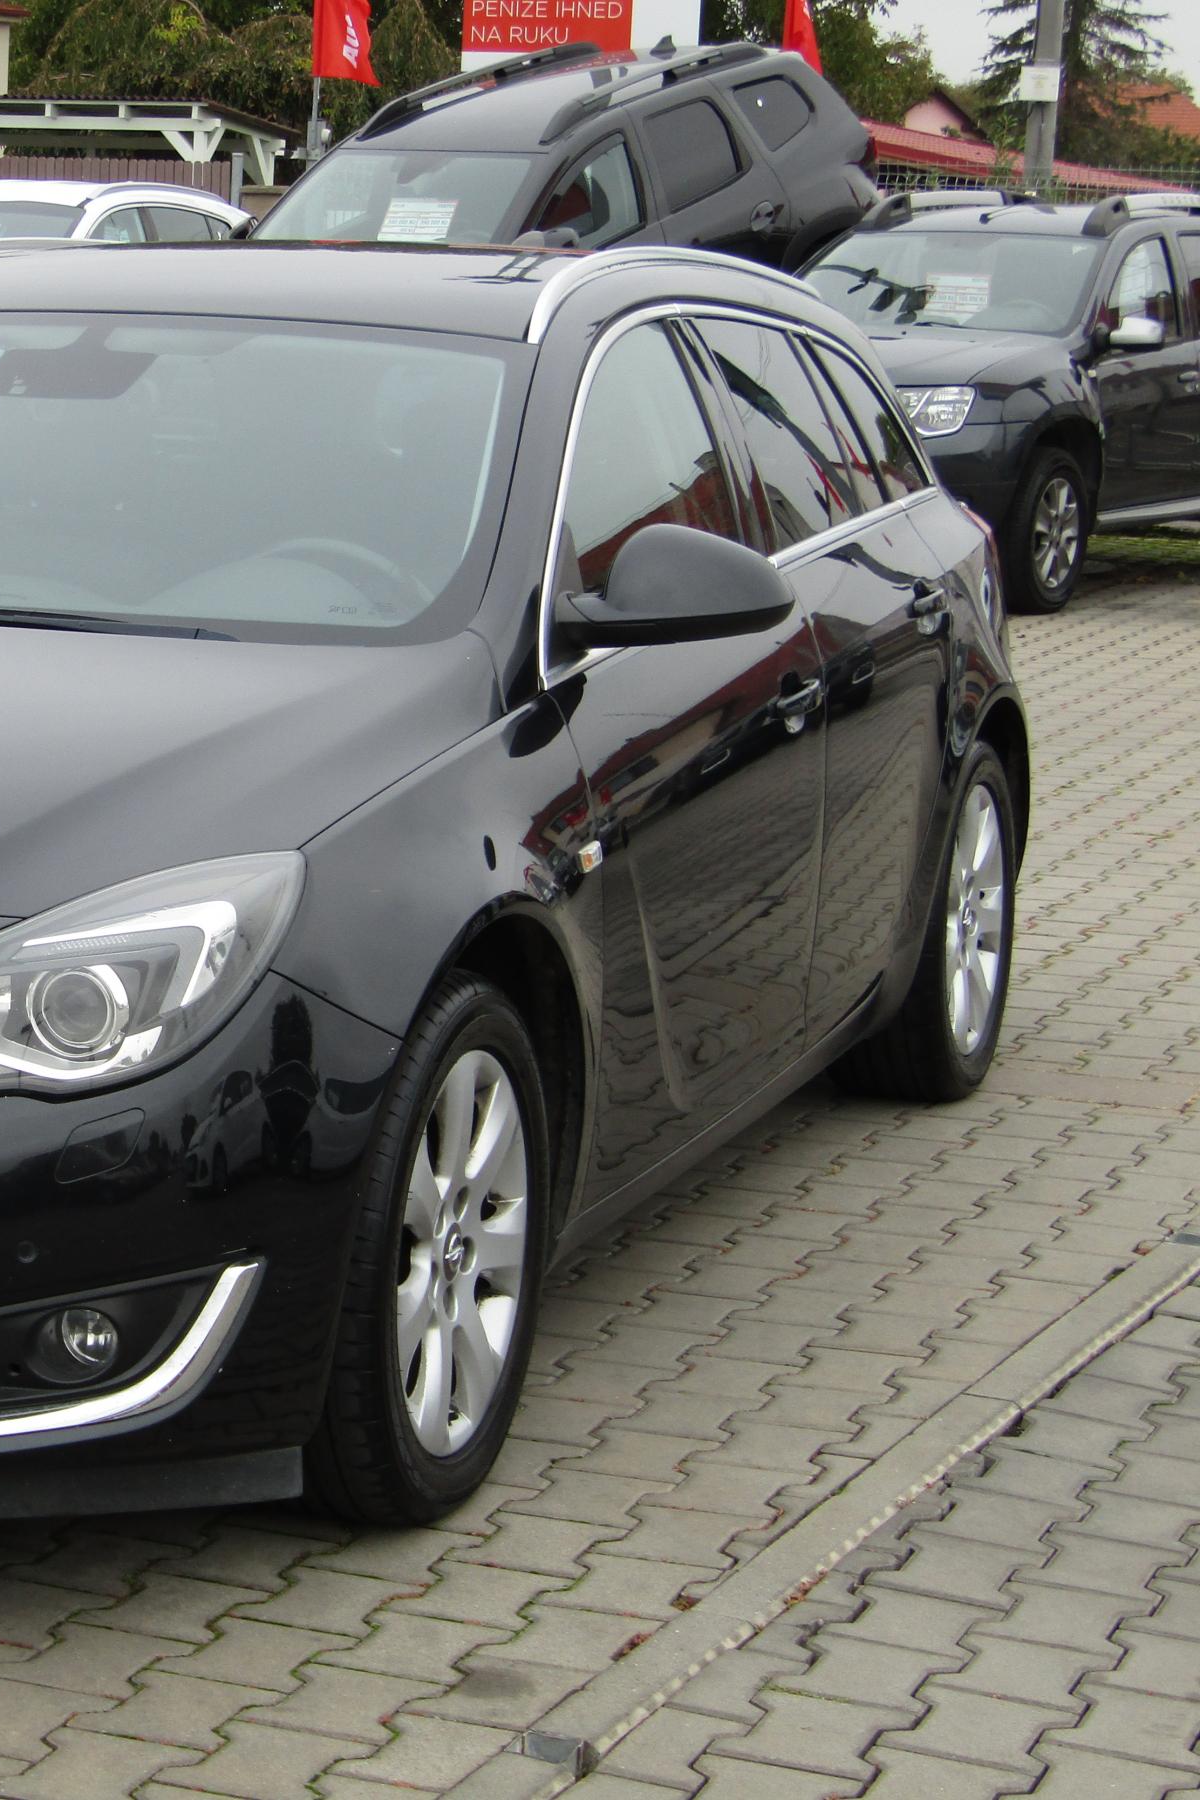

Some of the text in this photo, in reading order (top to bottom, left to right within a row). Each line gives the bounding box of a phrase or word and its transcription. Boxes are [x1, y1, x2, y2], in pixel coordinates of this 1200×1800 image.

[555, 1, 623, 19] IHNED
[471, 26, 569, 44] NA RUKU
